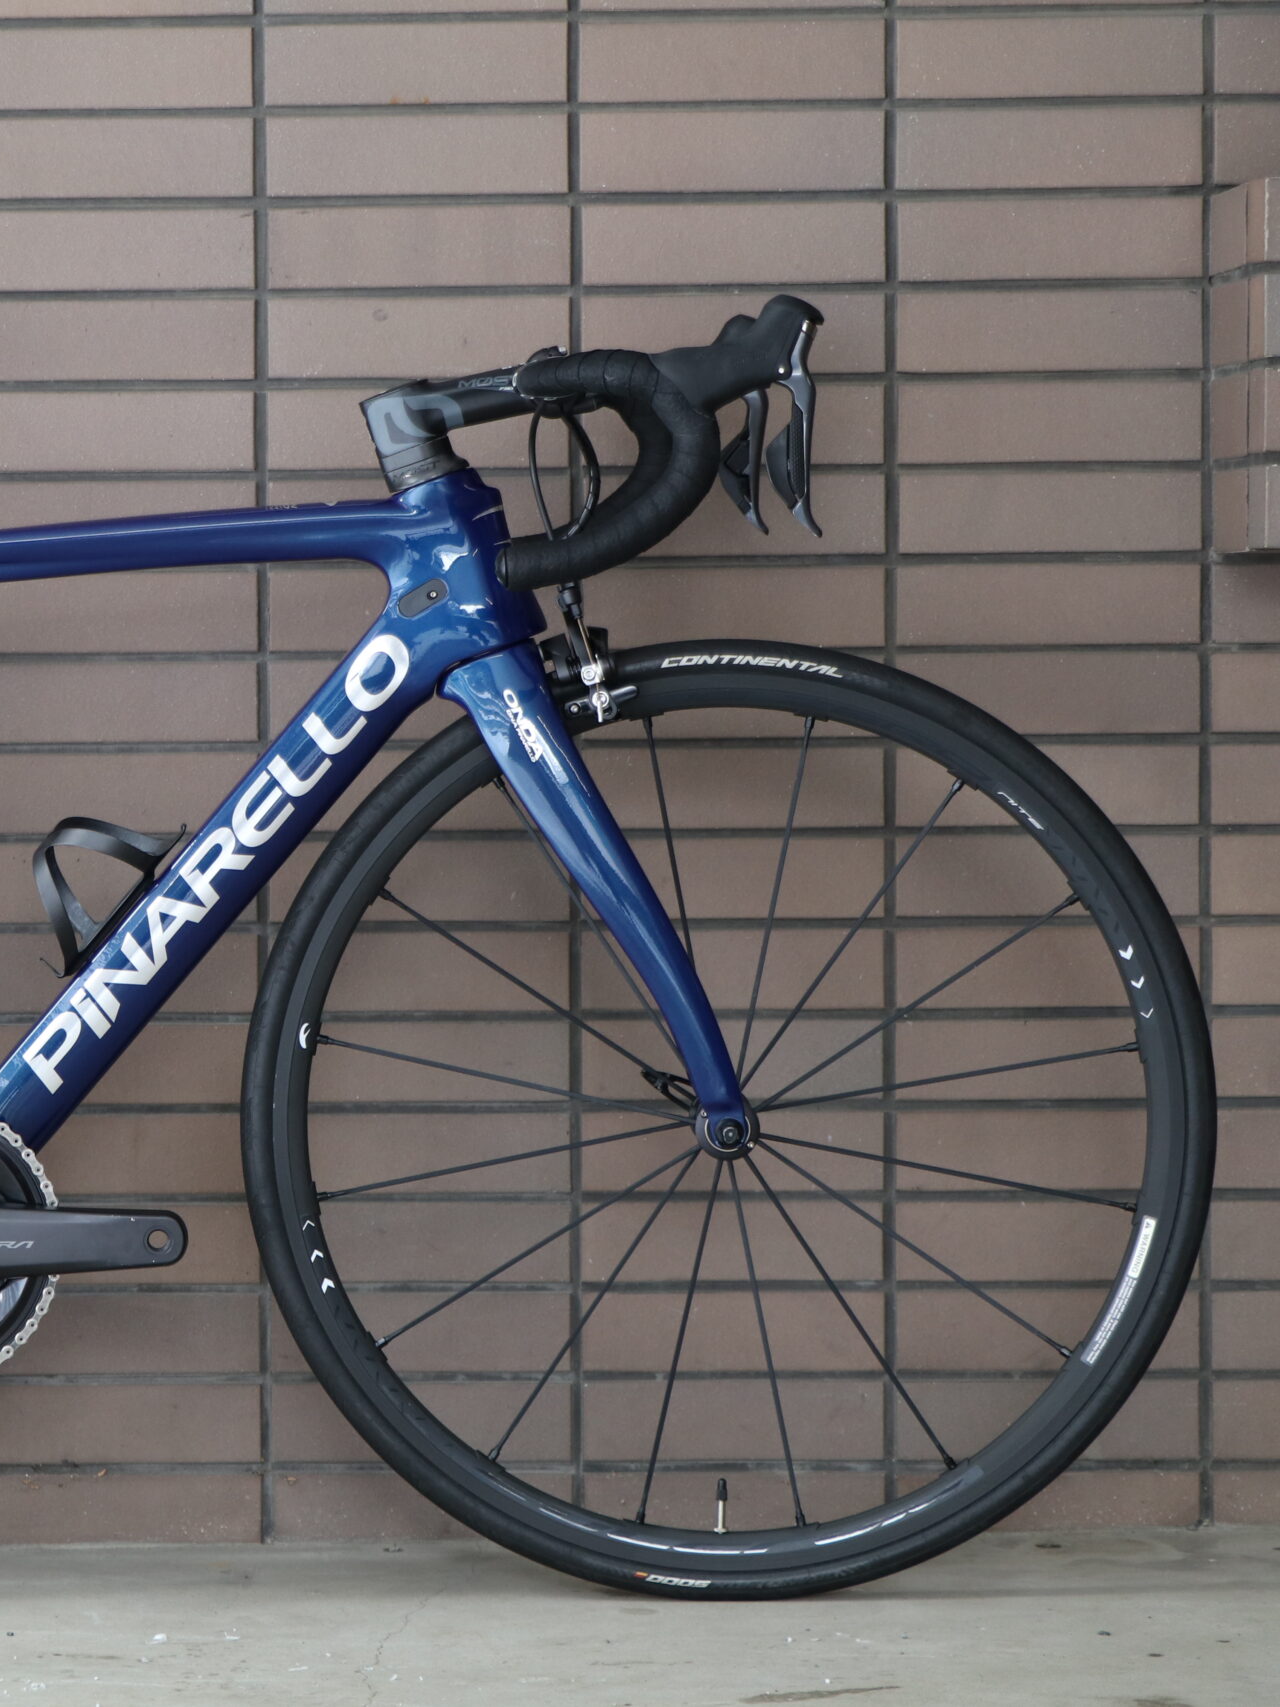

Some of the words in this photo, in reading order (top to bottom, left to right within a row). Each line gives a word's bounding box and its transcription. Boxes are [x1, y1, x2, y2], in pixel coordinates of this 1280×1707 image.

[660, 654, 844, 679] CONTINENTAL
[502, 688, 544, 761] ONDA
[21, 634, 410, 1095] PINARELLO
[645, 1574, 712, 1588] 5000
